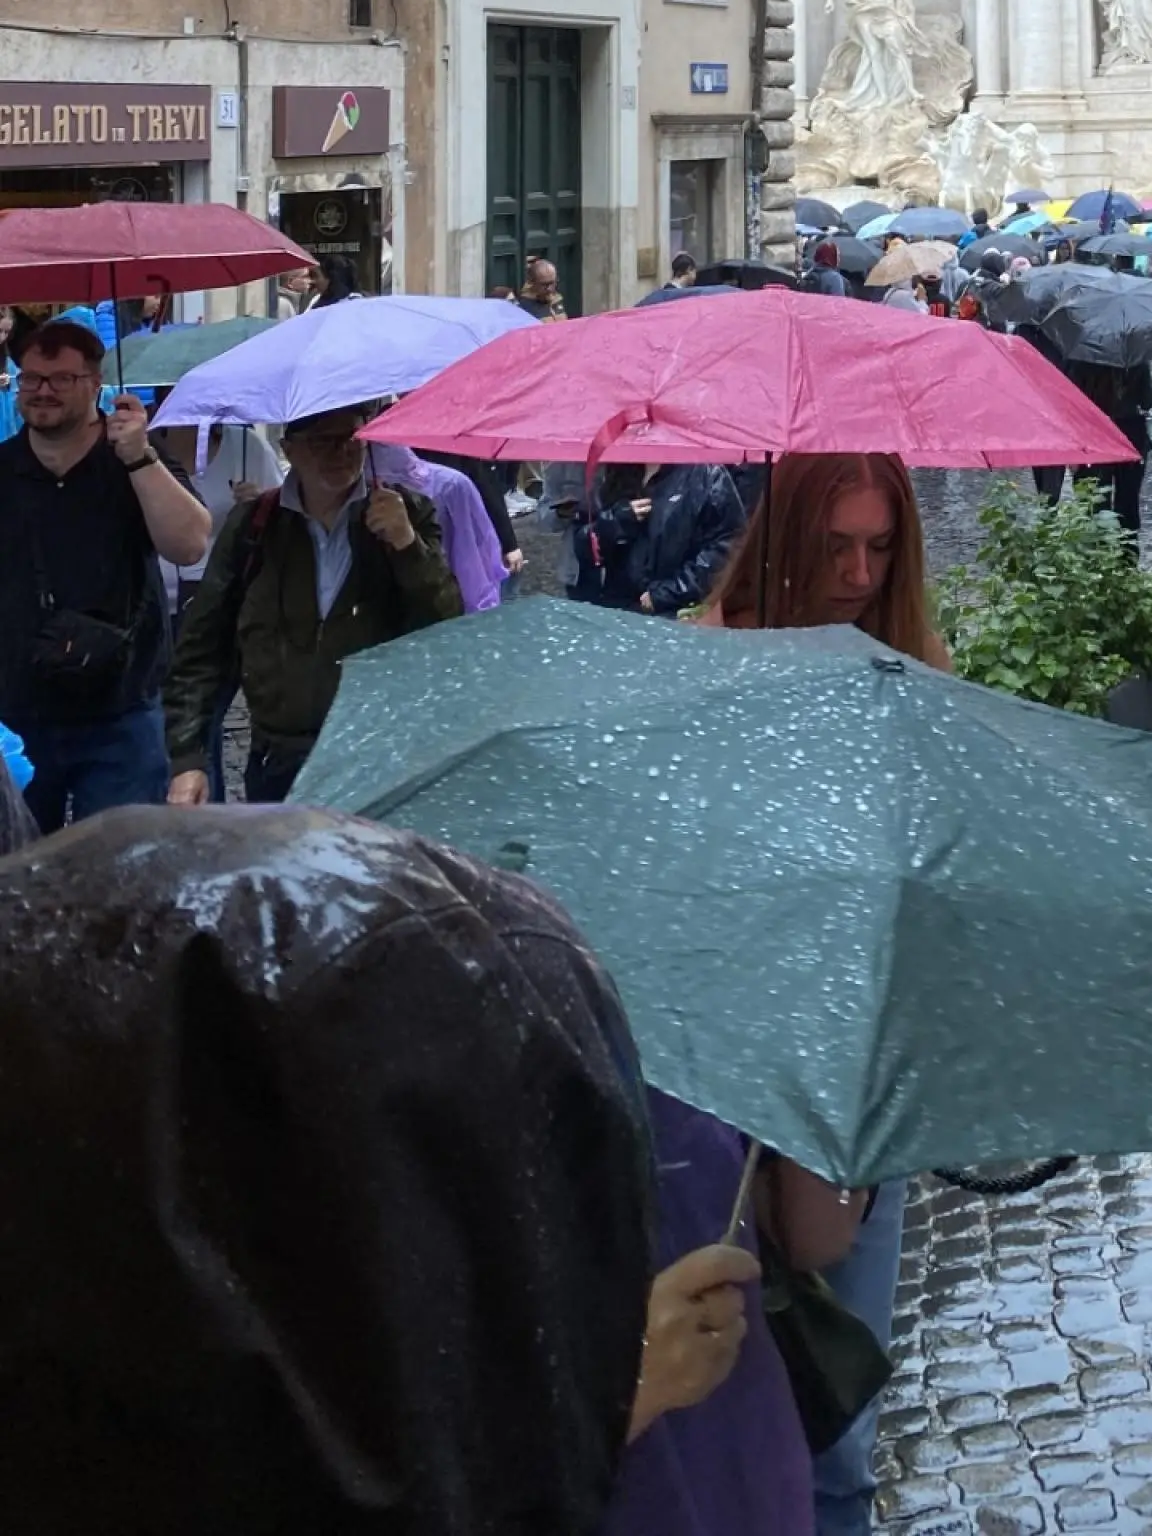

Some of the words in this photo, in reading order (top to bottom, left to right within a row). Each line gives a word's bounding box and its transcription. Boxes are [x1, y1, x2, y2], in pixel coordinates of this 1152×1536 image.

[0, 104, 108, 145] GELATO
[126, 104, 206, 142] TREVI
[222, 99, 233, 120] 31
